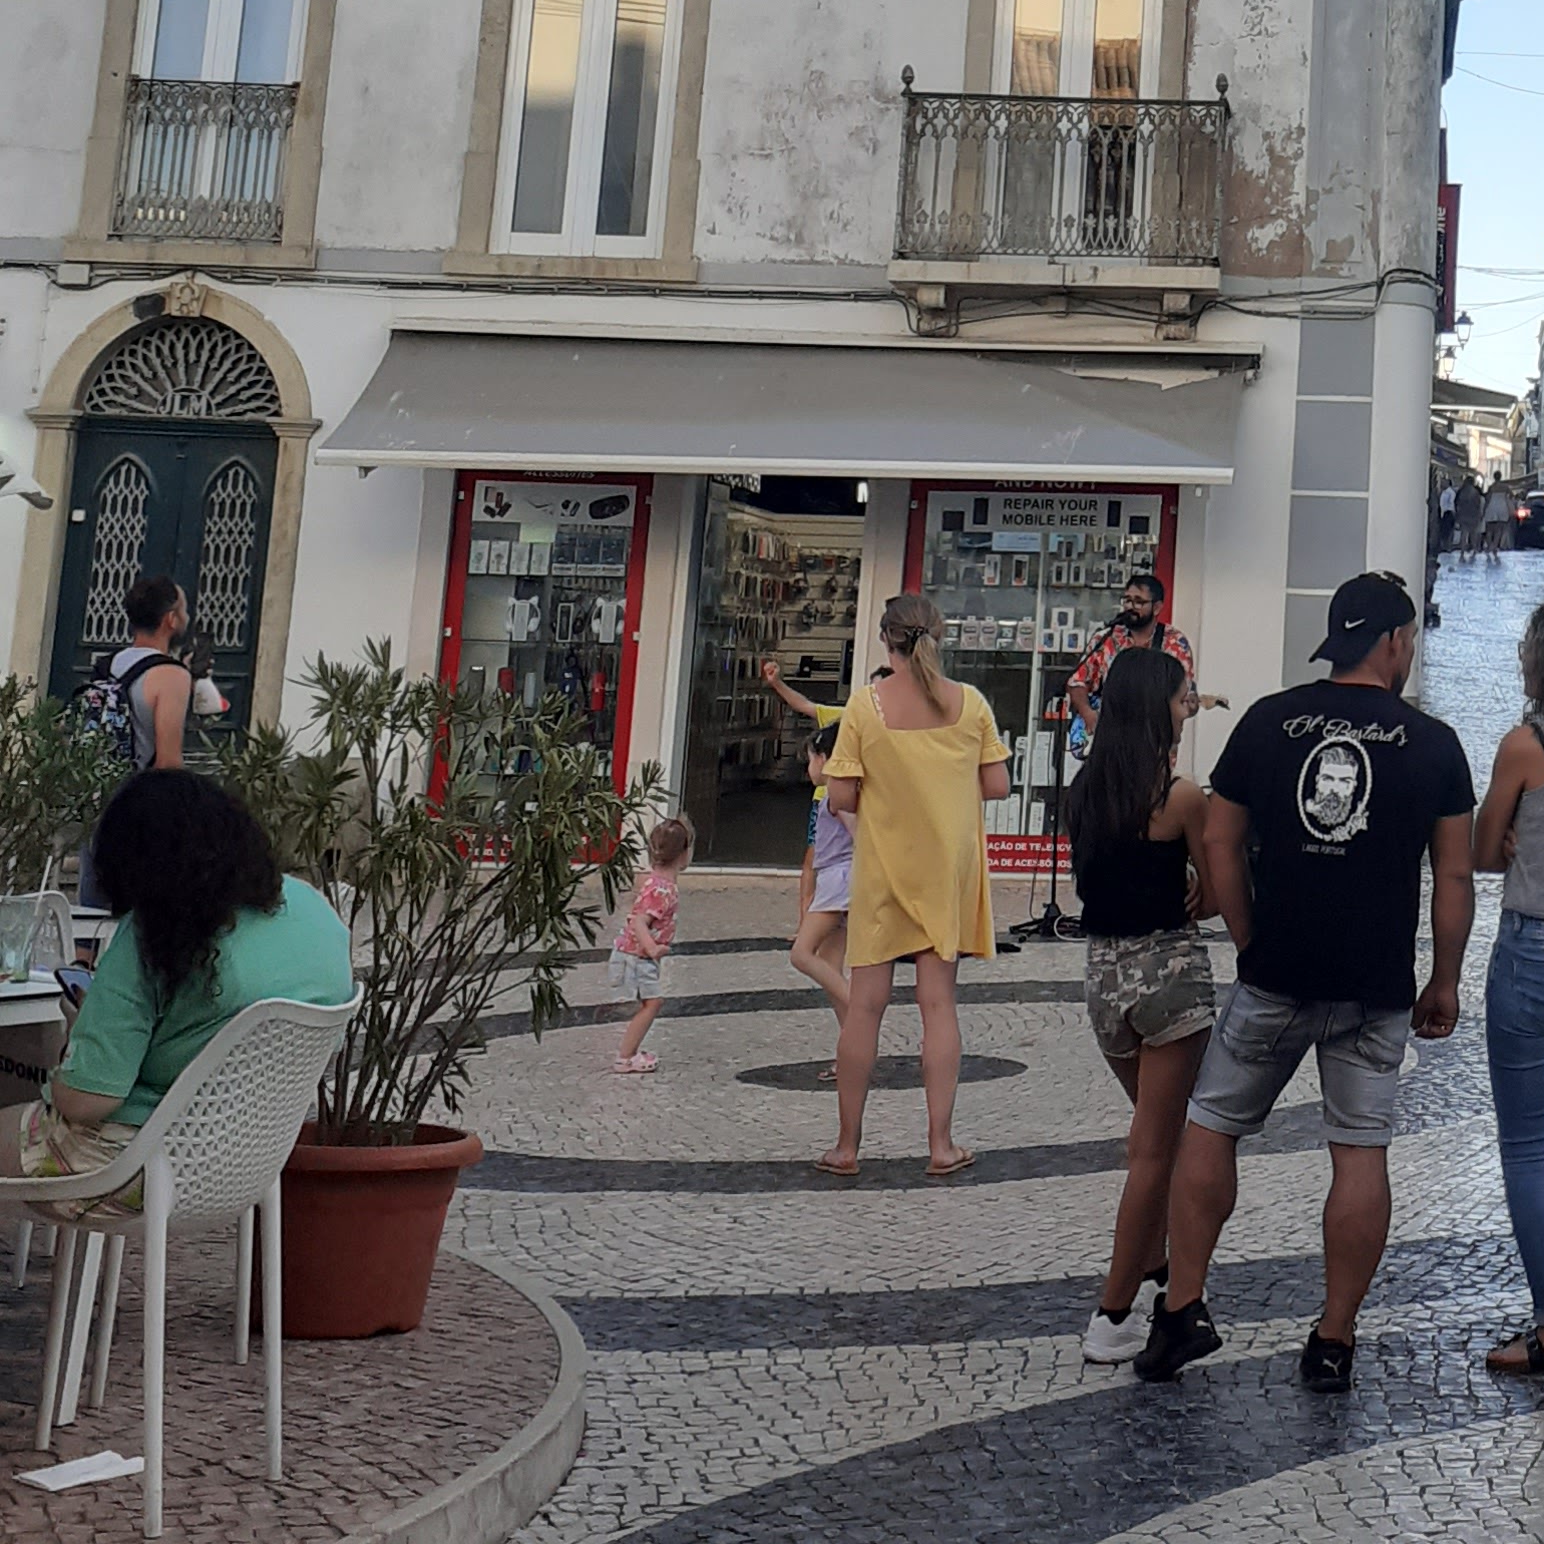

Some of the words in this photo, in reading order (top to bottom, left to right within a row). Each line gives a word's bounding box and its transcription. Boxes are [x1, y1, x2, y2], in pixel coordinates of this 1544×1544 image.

[160, 393, 207, 416] JLM
[994, 480, 1034, 489] AND
[1040, 481, 1084, 490] NOW
[1003, 497, 1055, 510] REPAIR
[1058, 499, 1099, 512] YOUR
[1002, 513, 1056, 527] MOBILE
[1060, 514, 1099, 527] HERE
[1322, 717, 1409, 747] Bastard's
[986, 841, 1014, 853] AÇÃO
[1014, 842, 1028, 852] DE
[1000, 858, 1013, 867] DE
